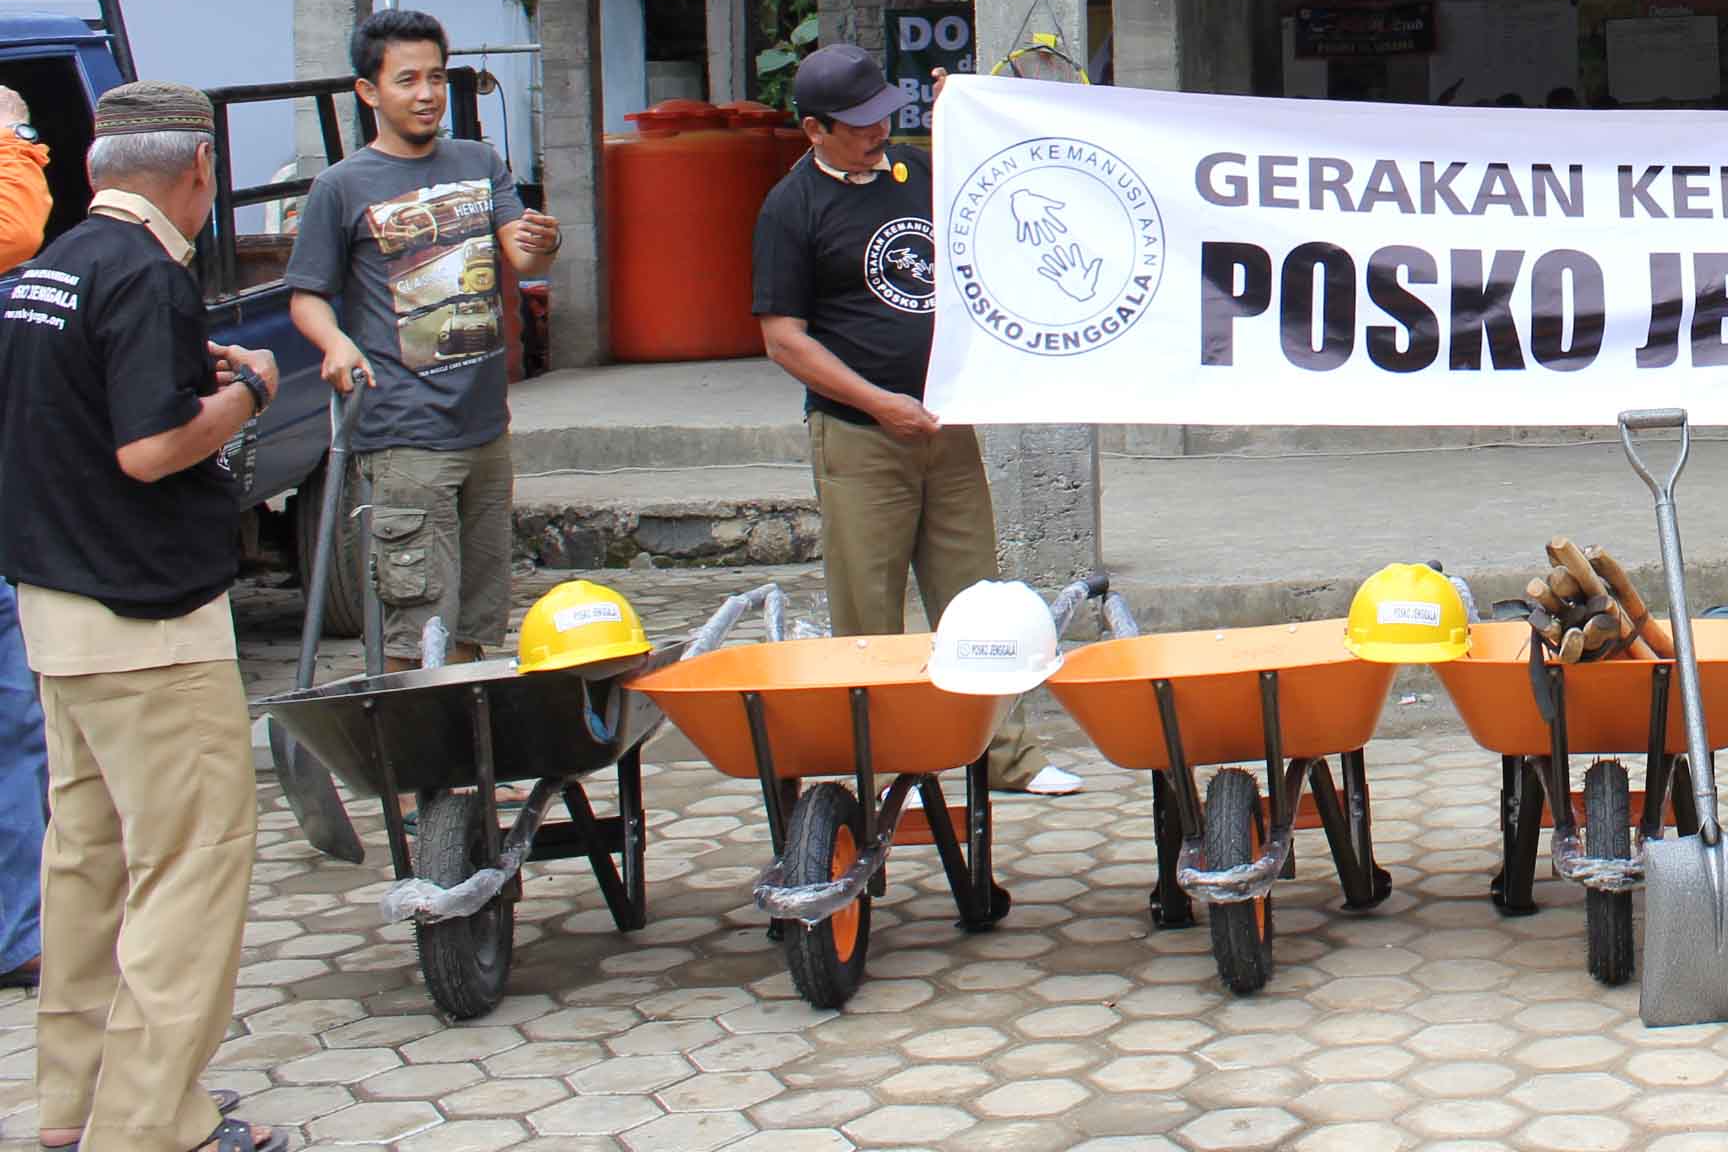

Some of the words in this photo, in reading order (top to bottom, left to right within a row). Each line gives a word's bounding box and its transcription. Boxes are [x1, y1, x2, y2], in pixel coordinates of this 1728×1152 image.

[952, 157, 1018, 256] GERAKAN
[1029, 144, 1158, 267] KEMANUSIAAN
[1195, 152, 1584, 217] GERAKAN
[957, 263, 1024, 341] POSKO
[1026, 274, 1153, 351] JENGGALA
[1200, 240, 1605, 373] POSKO
